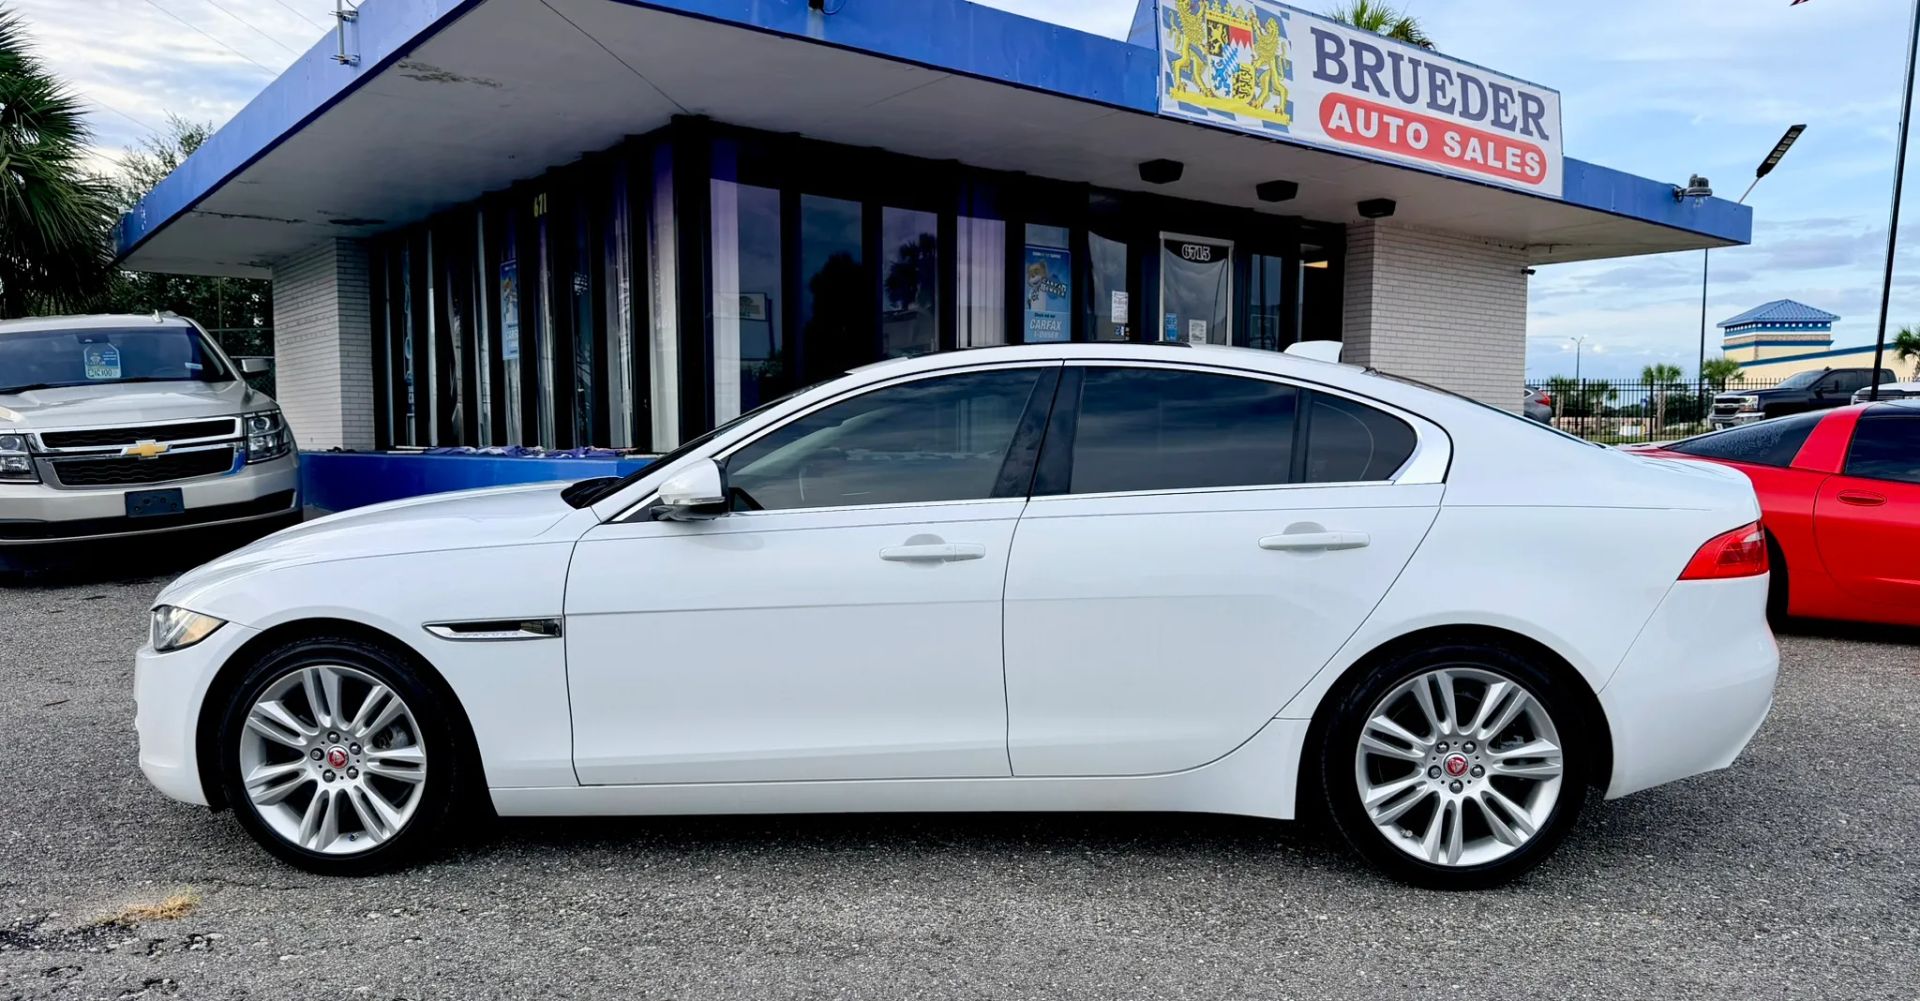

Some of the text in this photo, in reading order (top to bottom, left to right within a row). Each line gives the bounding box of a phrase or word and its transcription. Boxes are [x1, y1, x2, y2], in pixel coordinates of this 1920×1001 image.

[1310, 26, 1549, 141] BRUEDER
[1328, 102, 1541, 178] AUTO SALES
[1181, 244, 1211, 262] 6715
[1029, 318, 1062, 331] CARFAX
